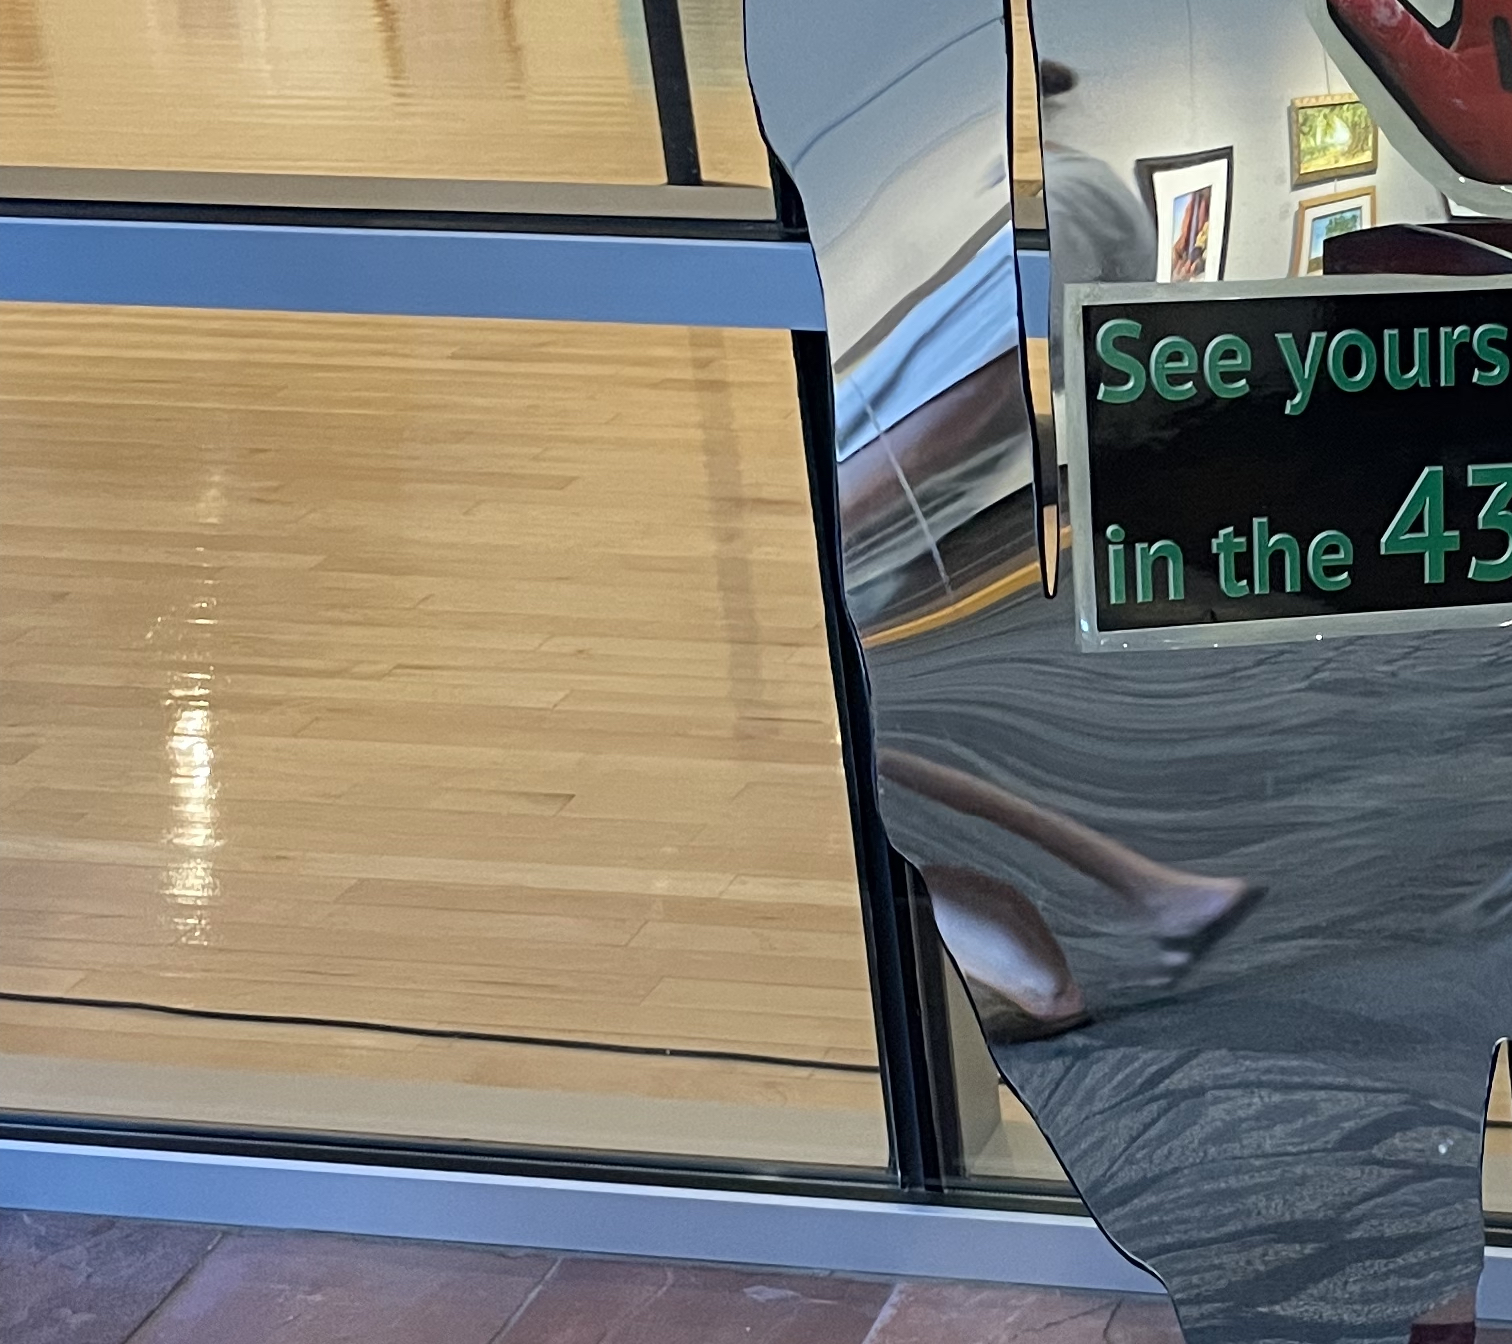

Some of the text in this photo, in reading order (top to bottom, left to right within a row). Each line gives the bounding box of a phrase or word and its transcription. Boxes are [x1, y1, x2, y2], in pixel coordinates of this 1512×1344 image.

[1096, 318, 1252, 404] See
[1105, 523, 1186, 605] in
[1212, 516, 1354, 599] the
